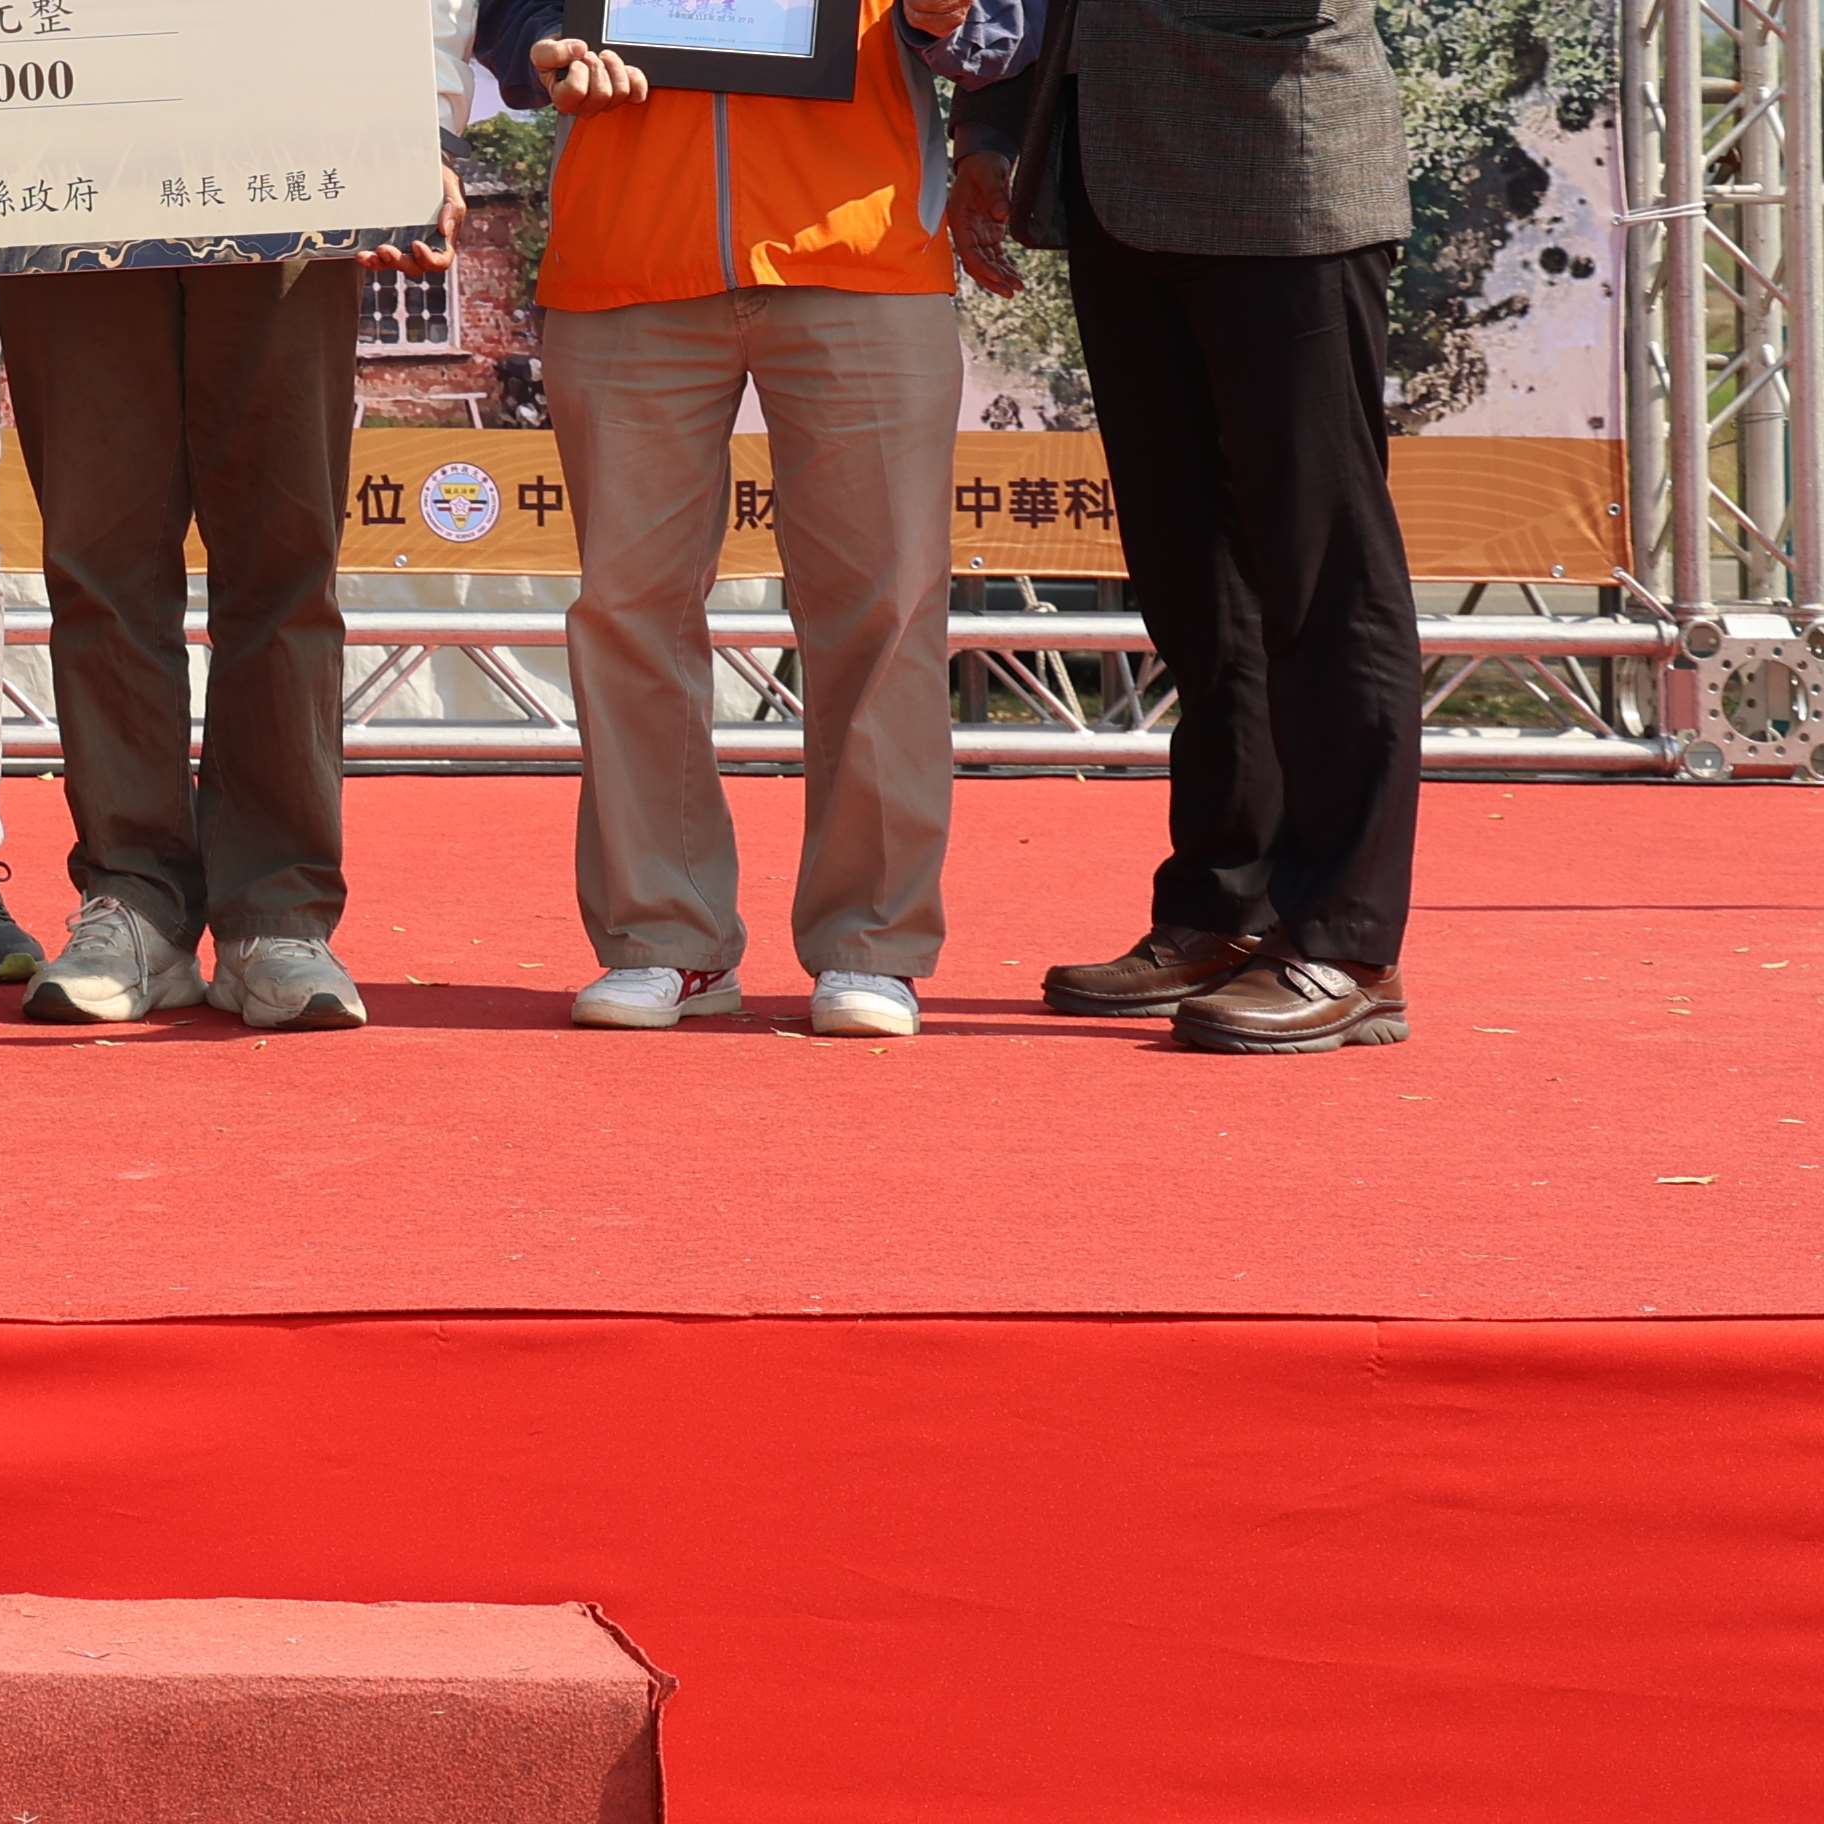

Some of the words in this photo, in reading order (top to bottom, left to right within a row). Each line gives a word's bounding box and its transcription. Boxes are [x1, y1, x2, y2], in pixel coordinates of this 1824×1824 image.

[159, 175, 225, 209] 縣長
[247, 168, 346, 205] 張麗善
[956, 477, 1114, 529] 中華科
